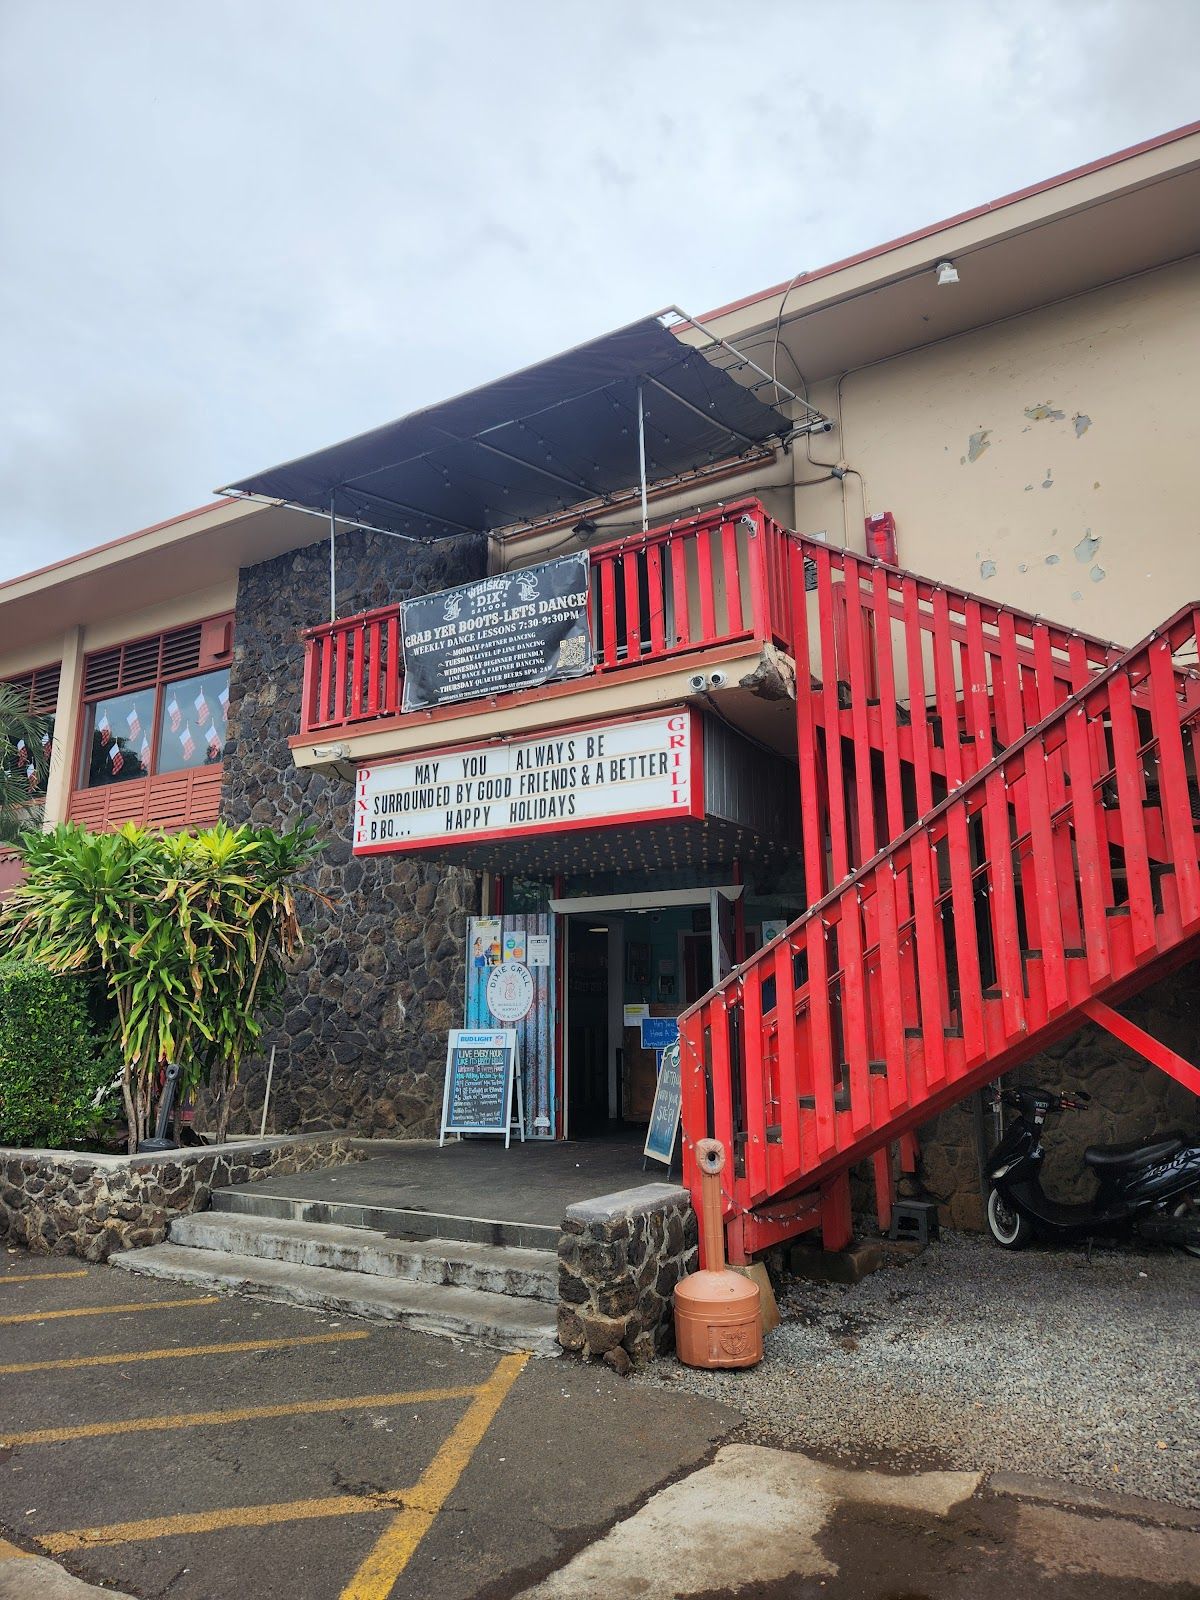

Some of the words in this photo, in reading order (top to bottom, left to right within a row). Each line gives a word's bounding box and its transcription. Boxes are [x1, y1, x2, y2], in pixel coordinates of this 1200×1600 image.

[467, 578, 511, 600] WHISKEY
[471, 602, 507, 615] SALOON
[405, 631, 432, 648] GRAB
[433, 625, 456, 641] YER
[413, 639, 446, 656] WEEKLY
[447, 633, 476, 646] DANCE
[477, 625, 517, 640] LESSONS
[518, 610, 580, 631] 7:30-9:30PM
[509, 632, 536, 643] DANCING
[493, 648, 501, 656] UP
[502, 645, 516, 654] LINE
[517, 640, 545, 650] DANCING
[514, 649, 544, 661] FRIENDLY
[448, 674, 461, 683] LINE
[461, 670, 480, 680] DANCE
[487, 663, 514, 674] PARTNER
[516, 658, 545, 668] DANCING
[503, 670, 523, 679] BEERS
[415, 763, 440, 786] MAY
[462, 755, 487, 778] YOU
[516, 740, 575, 771] ALWAYS
[586, 735, 605, 757] BE
[667, 716, 687, 804] GRILL
[374, 787, 450, 815] SURROUNDED
[456, 783, 473, 804] BY
[477, 776, 512, 801] GOOD
[520, 767, 577, 796] FRIENDS
[581, 765, 590, 786] &
[596, 762, 605, 784] A
[610, 752, 669, 781] BETTER
[357, 769, 371, 843] DIXIE
[445, 806, 491, 831] HAPPY
[509, 794, 575, 823] HOLIDAYS
[490, 966, 507, 988] DIXIE
[511, 965, 530, 988] GRILL
